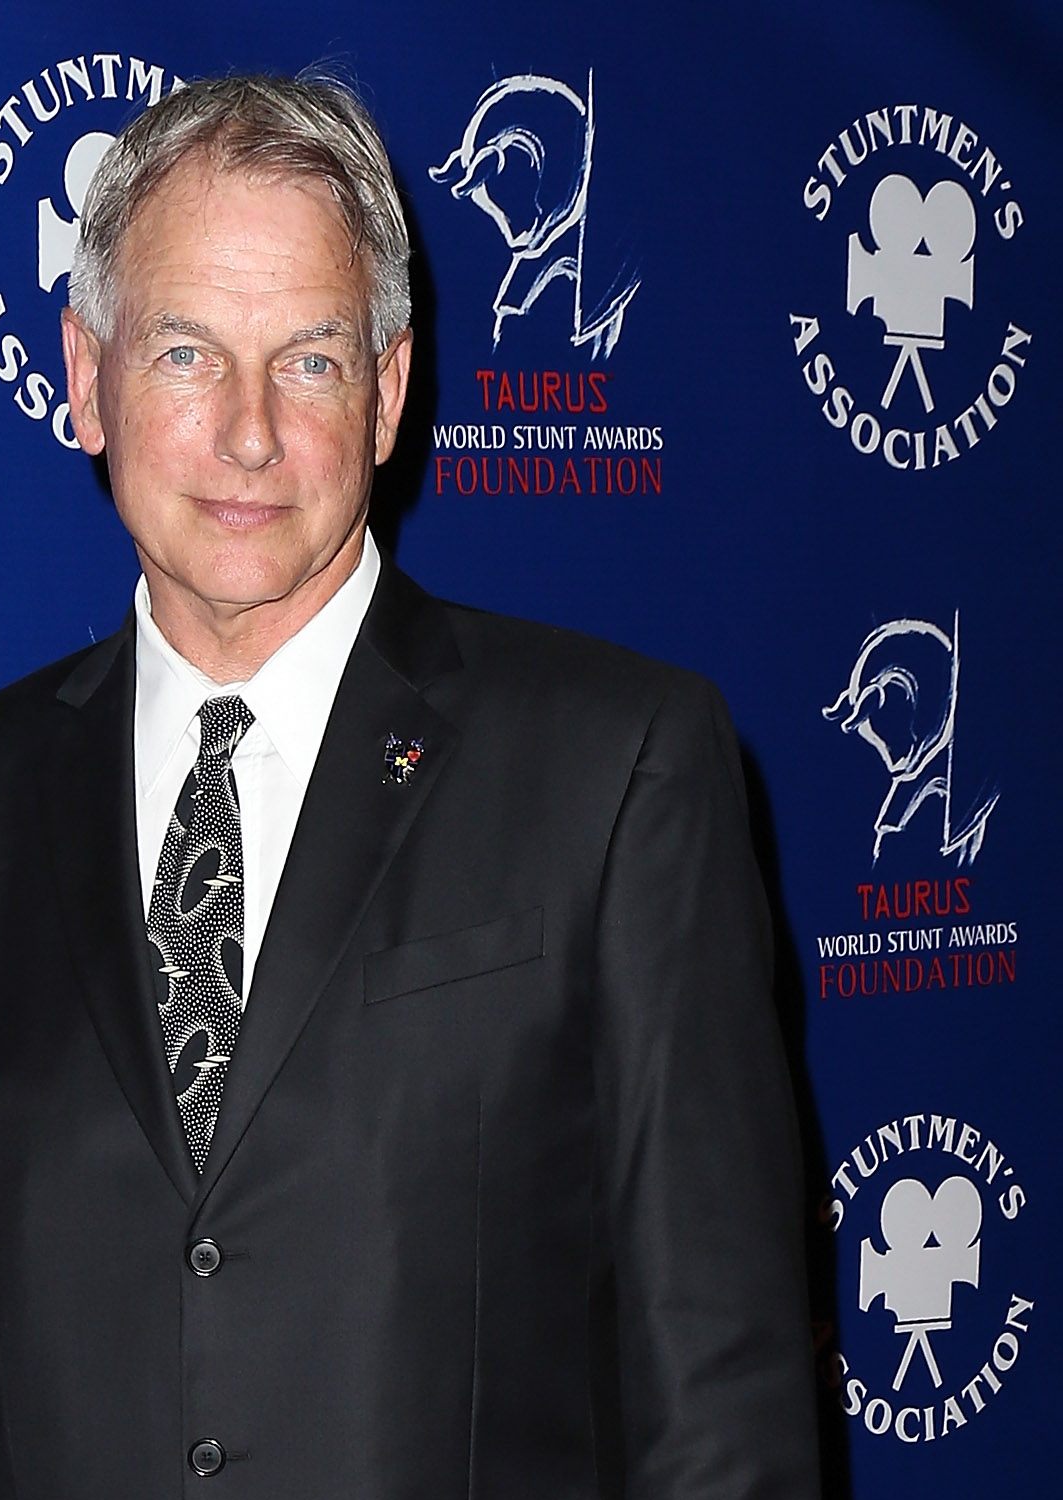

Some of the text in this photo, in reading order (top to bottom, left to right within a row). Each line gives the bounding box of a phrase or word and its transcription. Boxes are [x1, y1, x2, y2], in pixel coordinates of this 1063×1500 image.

[803, 104, 1024, 240] STUNTMEN'S
[789, 312, 1032, 471] ASSOCIATION
[432, 424, 664, 450] WORLD STUNT AWARDS
[435, 456, 661, 495] FOUNDATION
[817, 922, 1018, 958] WORLD STUNT AWARDS
[821, 951, 1015, 999] FOUNDATION
